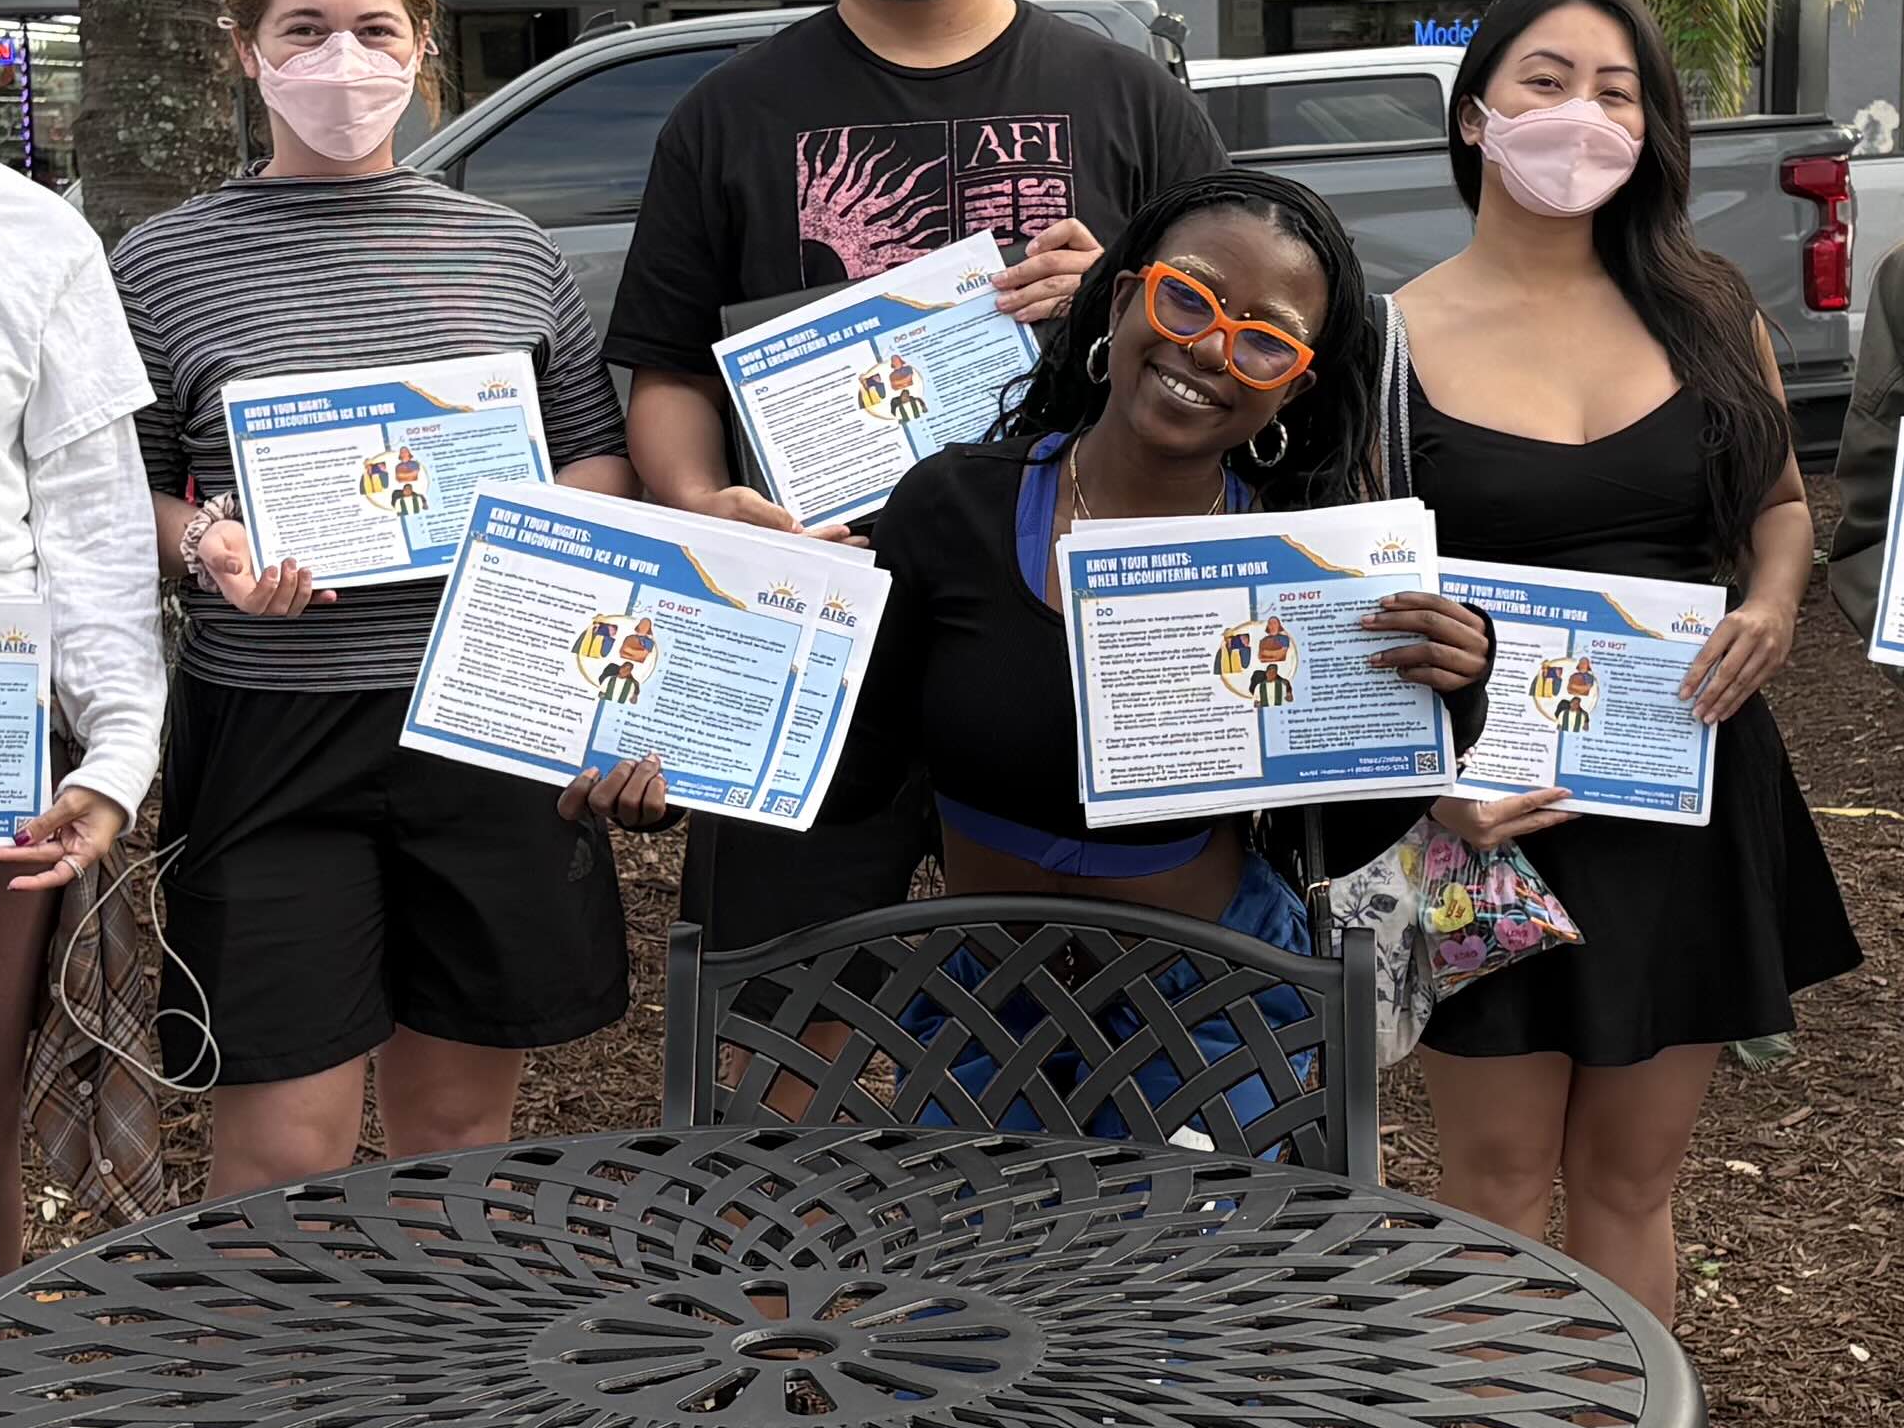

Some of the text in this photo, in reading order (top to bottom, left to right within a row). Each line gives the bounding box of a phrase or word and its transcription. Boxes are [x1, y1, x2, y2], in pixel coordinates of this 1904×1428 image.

[964, 122, 1064, 169] AFI
[477, 387, 518, 402] RAISE
[489, 507, 522, 524] KNOW
[523, 515, 551, 533] YOUR
[486, 520, 660, 577] WHEN ENCOUNTERING ICE AT WORK
[1369, 549, 1418, 566] RAISE
[1086, 557, 1118, 575] KNOW
[1121, 555, 1148, 572] YOUR
[1087, 561, 1269, 589] WHEN ENCOUNTERING ICE AT WORK
[757, 591, 808, 614] RAISE
[818, 606, 858, 628] AISE
